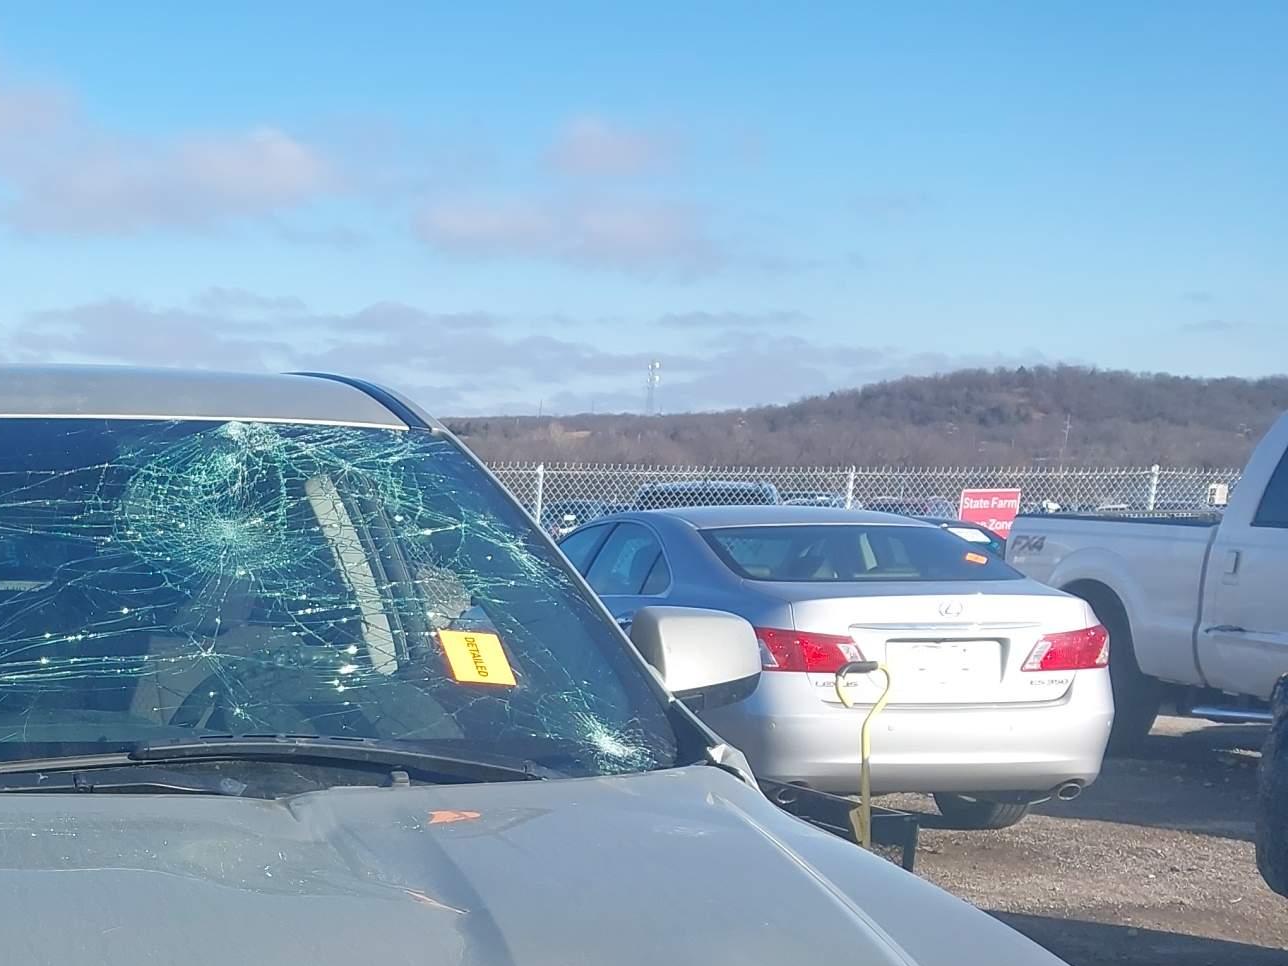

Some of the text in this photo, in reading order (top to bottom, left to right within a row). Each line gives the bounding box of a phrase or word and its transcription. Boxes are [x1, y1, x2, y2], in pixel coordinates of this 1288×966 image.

[963, 496, 1017, 508] State Farm
[1011, 535, 1046, 551] FX4
[464, 636, 489, 678] DETAILED
